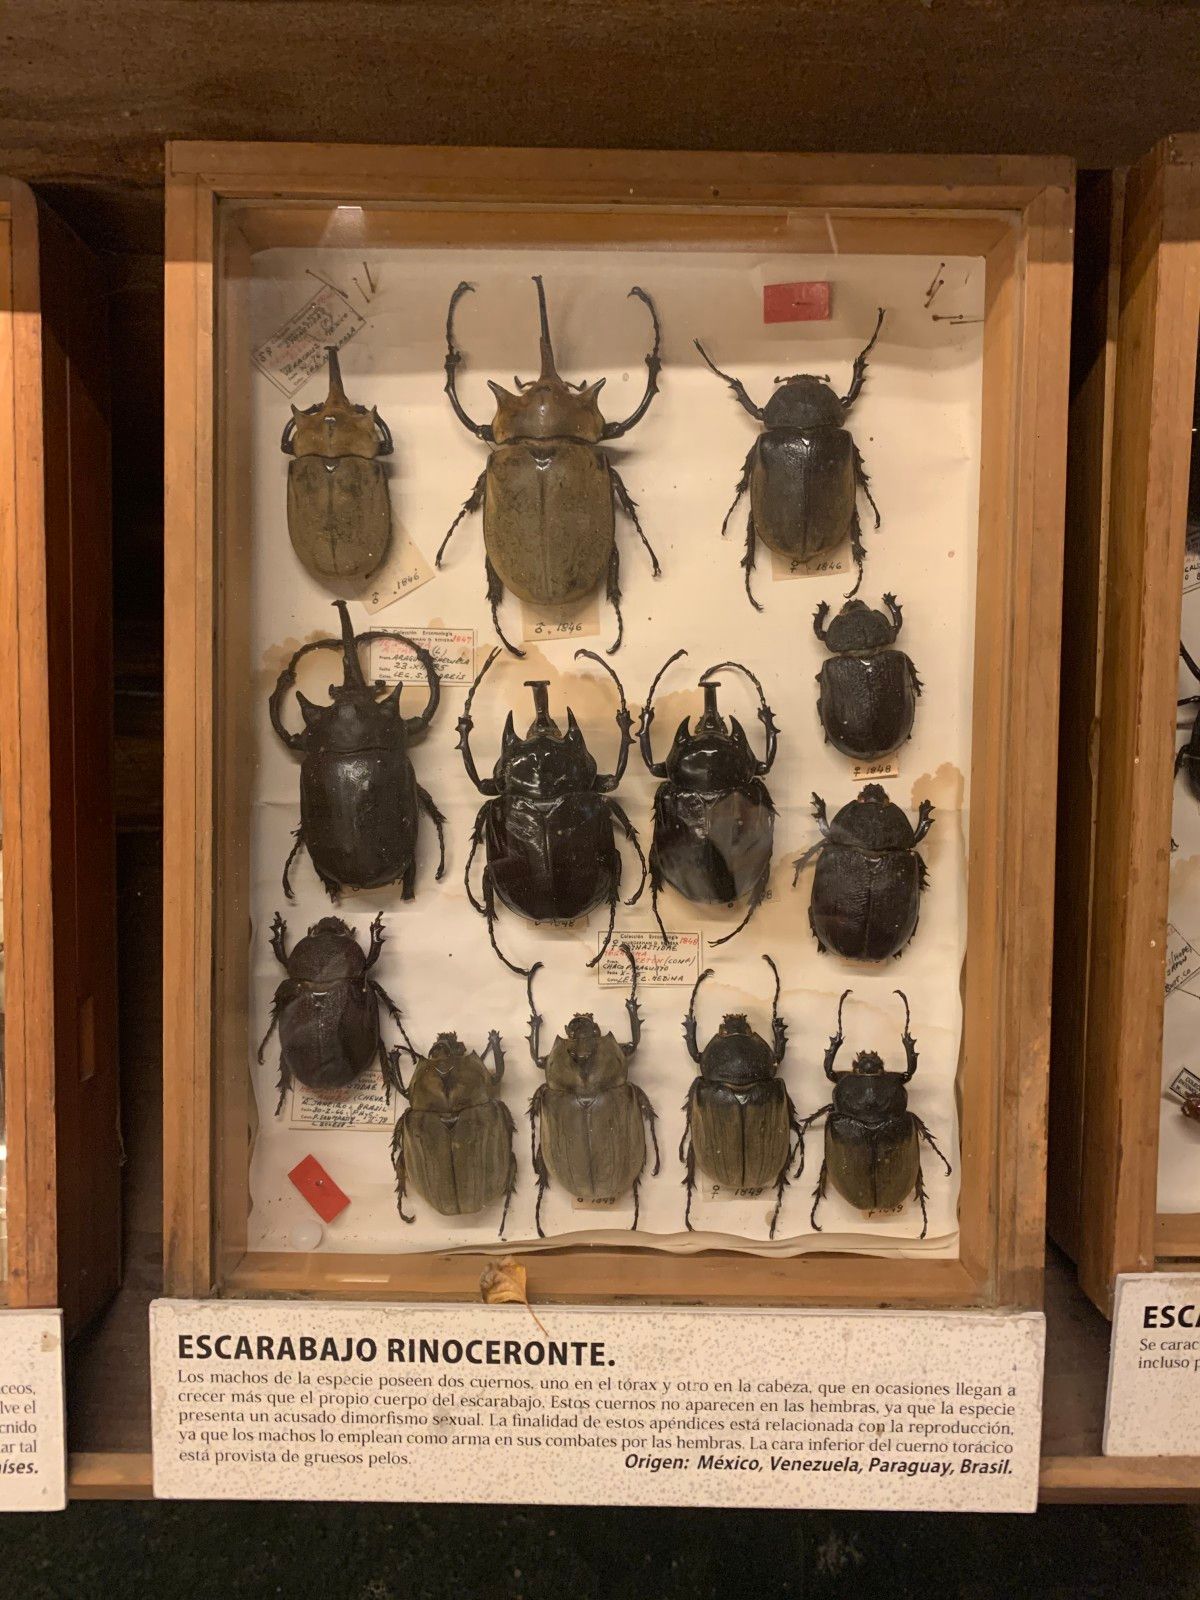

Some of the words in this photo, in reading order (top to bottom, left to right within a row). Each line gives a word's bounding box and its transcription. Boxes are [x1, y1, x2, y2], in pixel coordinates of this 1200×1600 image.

[177, 1334, 378, 1362] ESCARABAJO
[387, 1337, 616, 1367] RINOCERONTE.
[1140, 1339, 1156, 1351] Se
[1138, 1355, 1190, 1369] incluso
[178, 1370, 204, 1383] Los
[210, 1370, 268, 1384] machos
[274, 1371, 292, 1384] de
[297, 1371, 311, 1384] la
[317, 1373, 373, 1390] especie
[378, 1376, 432, 1391] poseen
[438, 1374, 464, 1388] dos
[470, 1378, 534, 1392] cuernos,
[540, 1379, 570, 1391] uno
[575, 1378, 593, 1390] en
[598, 1377, 611, 1390] el
[618, 1378, 659, 1392] tórax
[662, 1381, 671, 1395] y
[677, 1380, 708, 1392] otro
[713, 1382, 732, 1393] en
[738, 1379, 751, 1393] la
[757, 1379, 812, 1394] cabeza,
[818, 1384, 845, 1398] que
[852, 1384, 870, 1395] en
[875, 1381, 950, 1396] ocasiones
[956, 1382, 1002, 1400] llegan
[1007, 1387, 1016, 1396] a
[24, 1400, 36, 1414] el
[178, 1392, 226, 1403] crecer
[231, 1390, 262, 1404] más
[267, 1393, 295, 1408] que
[301, 1390, 313, 1406] el
[319, 1392, 369, 1409] propio
[374, 1395, 427, 1410] cuerpo
[432, 1393, 455, 1410] del
[460, 1392, 545, 1412] escarabajo.
[551, 1395, 590, 1413] Estos
[595, 1399, 657, 1411] cuernos
[661, 1400, 680, 1411] no
[685, 1400, 754, 1416] aparecen
[760, 1402, 778, 1412] en
[784, 1399, 804, 1412] las
[810, 1399, 879, 1414] hembras,
[883, 1403, 902, 1418] ya
[907, 1404, 935, 1418] que
[940, 1401, 954, 1414] la
[959, 1402, 1015, 1420] especie
[179, 1410, 245, 1425] presenta
[249, 1412, 269, 1422] un
[274, 1409, 336, 1424] acusado
[341, 1410, 428, 1427] dimorfismo
[432, 1412, 483, 1429] sexual.
[490, 1413, 507, 1427] La
[512, 1413, 578, 1429] finalidad
[583, 1414, 601, 1429] de
[606, 1417, 645, 1429] estos
[649, 1416, 725, 1434] apéndices
[730, 1417, 760, 1431] está
[766, 1417, 853, 1433] relacionada
[858, 1422, 885, 1436] con
[889, 1419, 903, 1433] la
[908, 1420, 1014, 1438] reproducción,
[19, 1440, 37, 1453] tal
[179, 1430, 196, 1445] ya
[201, 1431, 228, 1445] que
[232, 1427, 254, 1441] los
[259, 1428, 316, 1444] machos
[320, 1429, 334, 1443] lo
[338, 1429, 402, 1448] emplean
[407, 1434, 448, 1445] como
[452, 1435, 490, 1446] arma
[495, 1436, 512, 1446] en
[516, 1436, 542, 1447] sus
[545, 1433, 617, 1449] combates
[621, 1438, 647, 1452] por
[652, 1435, 672, 1449] las
[676, 1434, 744, 1451] hembras.
[750, 1437, 769, 1451] La
[771, 1440, 803, 1451] cara
[808, 1437, 865, 1453] inferior
[869, 1438, 891, 1452] del
[896, 1442, 948, 1453] cuerno
[953, 1440, 1013, 1454] torácico
[179, 1448, 210, 1462] está
[215, 1449, 277, 1466] provista
[281, 1449, 299, 1463] de
[304, 1453, 363, 1467] gruesos
[369, 1451, 411, 1468] pelos.
[625, 1453, 690, 1473] Origen:
[697, 1454, 763, 1472] México,
[771, 1455, 863, 1475] Venezuela,
[868, 1457, 955, 1477] Paraguay,
[960, 1459, 1012, 1474] Brasil.
